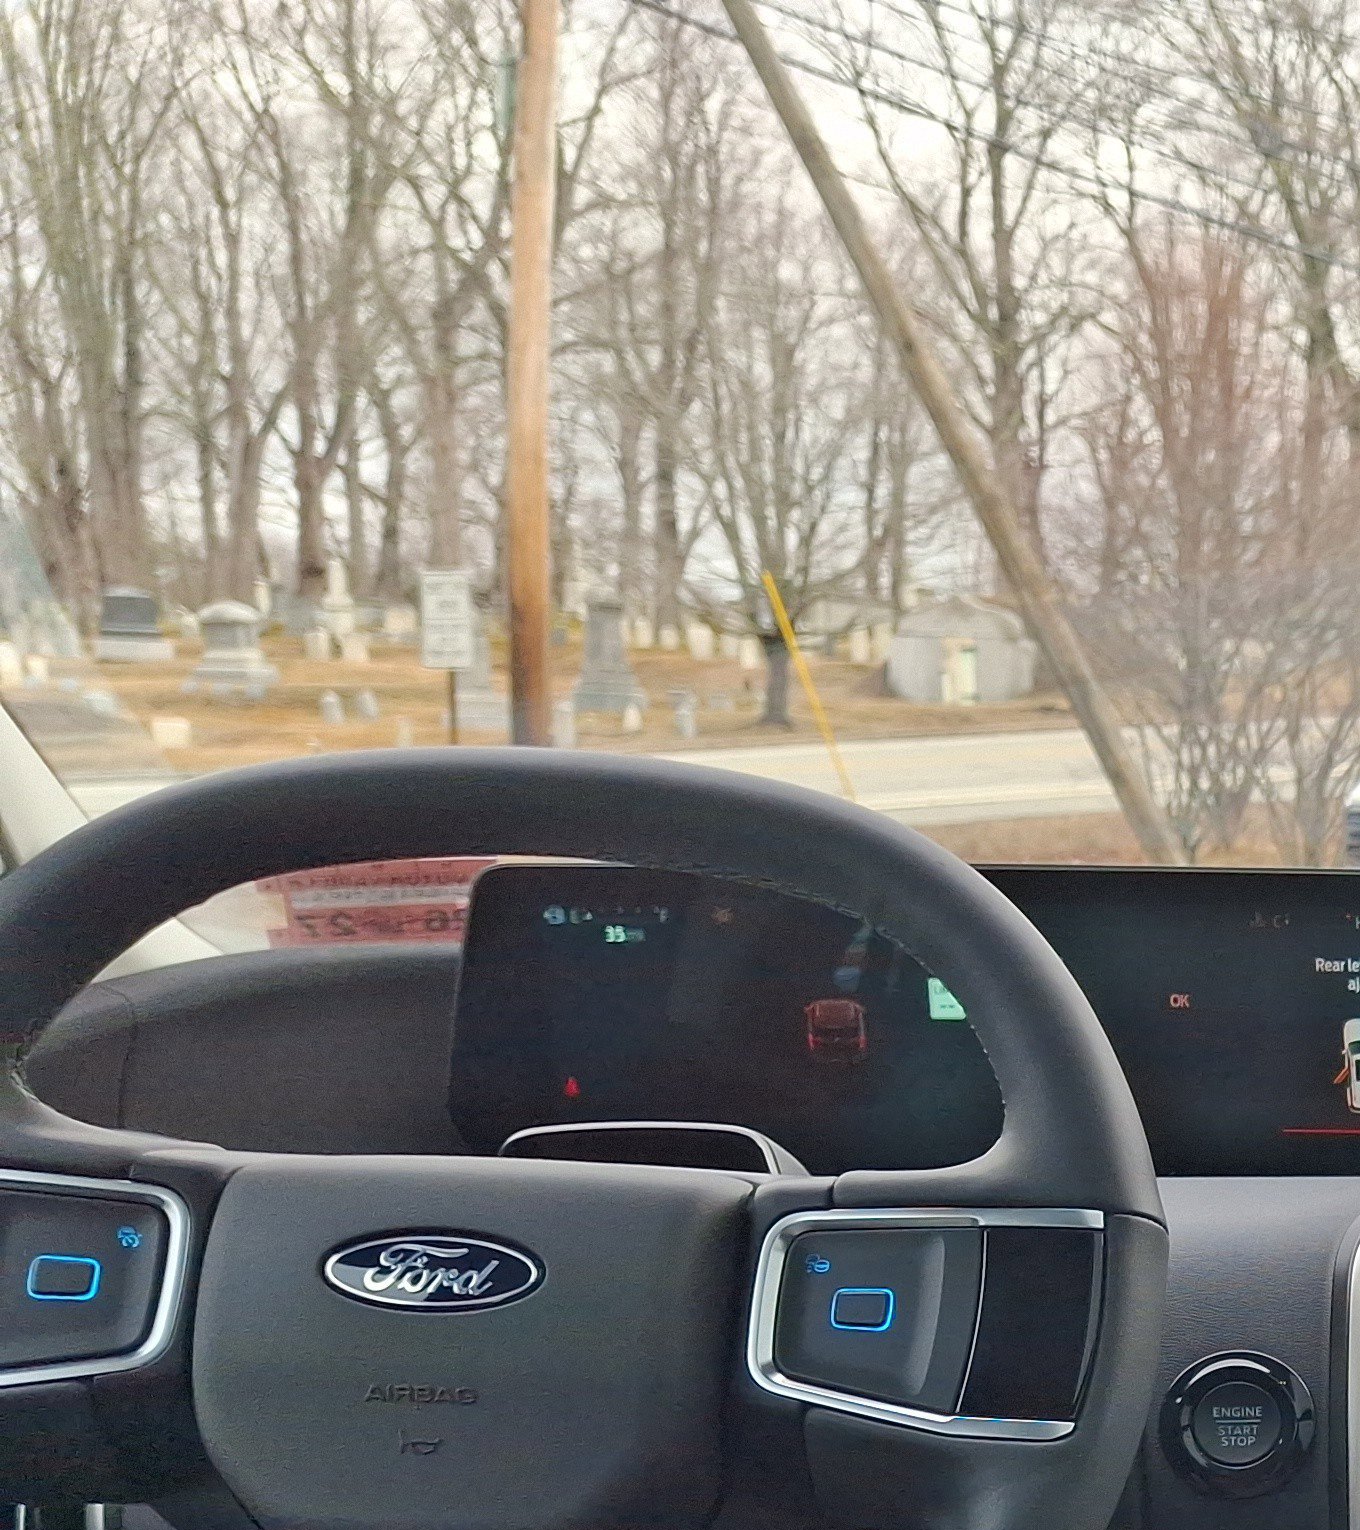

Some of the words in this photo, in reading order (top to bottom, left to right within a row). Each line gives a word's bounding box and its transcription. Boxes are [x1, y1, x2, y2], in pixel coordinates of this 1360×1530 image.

[1315, 958, 1345, 973] Rear
[1170, 994, 1190, 1008] OK
[363, 1243, 500, 1296] Ford
[364, 1383, 478, 1404] AIRBAG
[1212, 1406, 1263, 1418] ENGINE
[1217, 1424, 1258, 1436] START
[1221, 1435, 1256, 1447] STOP
